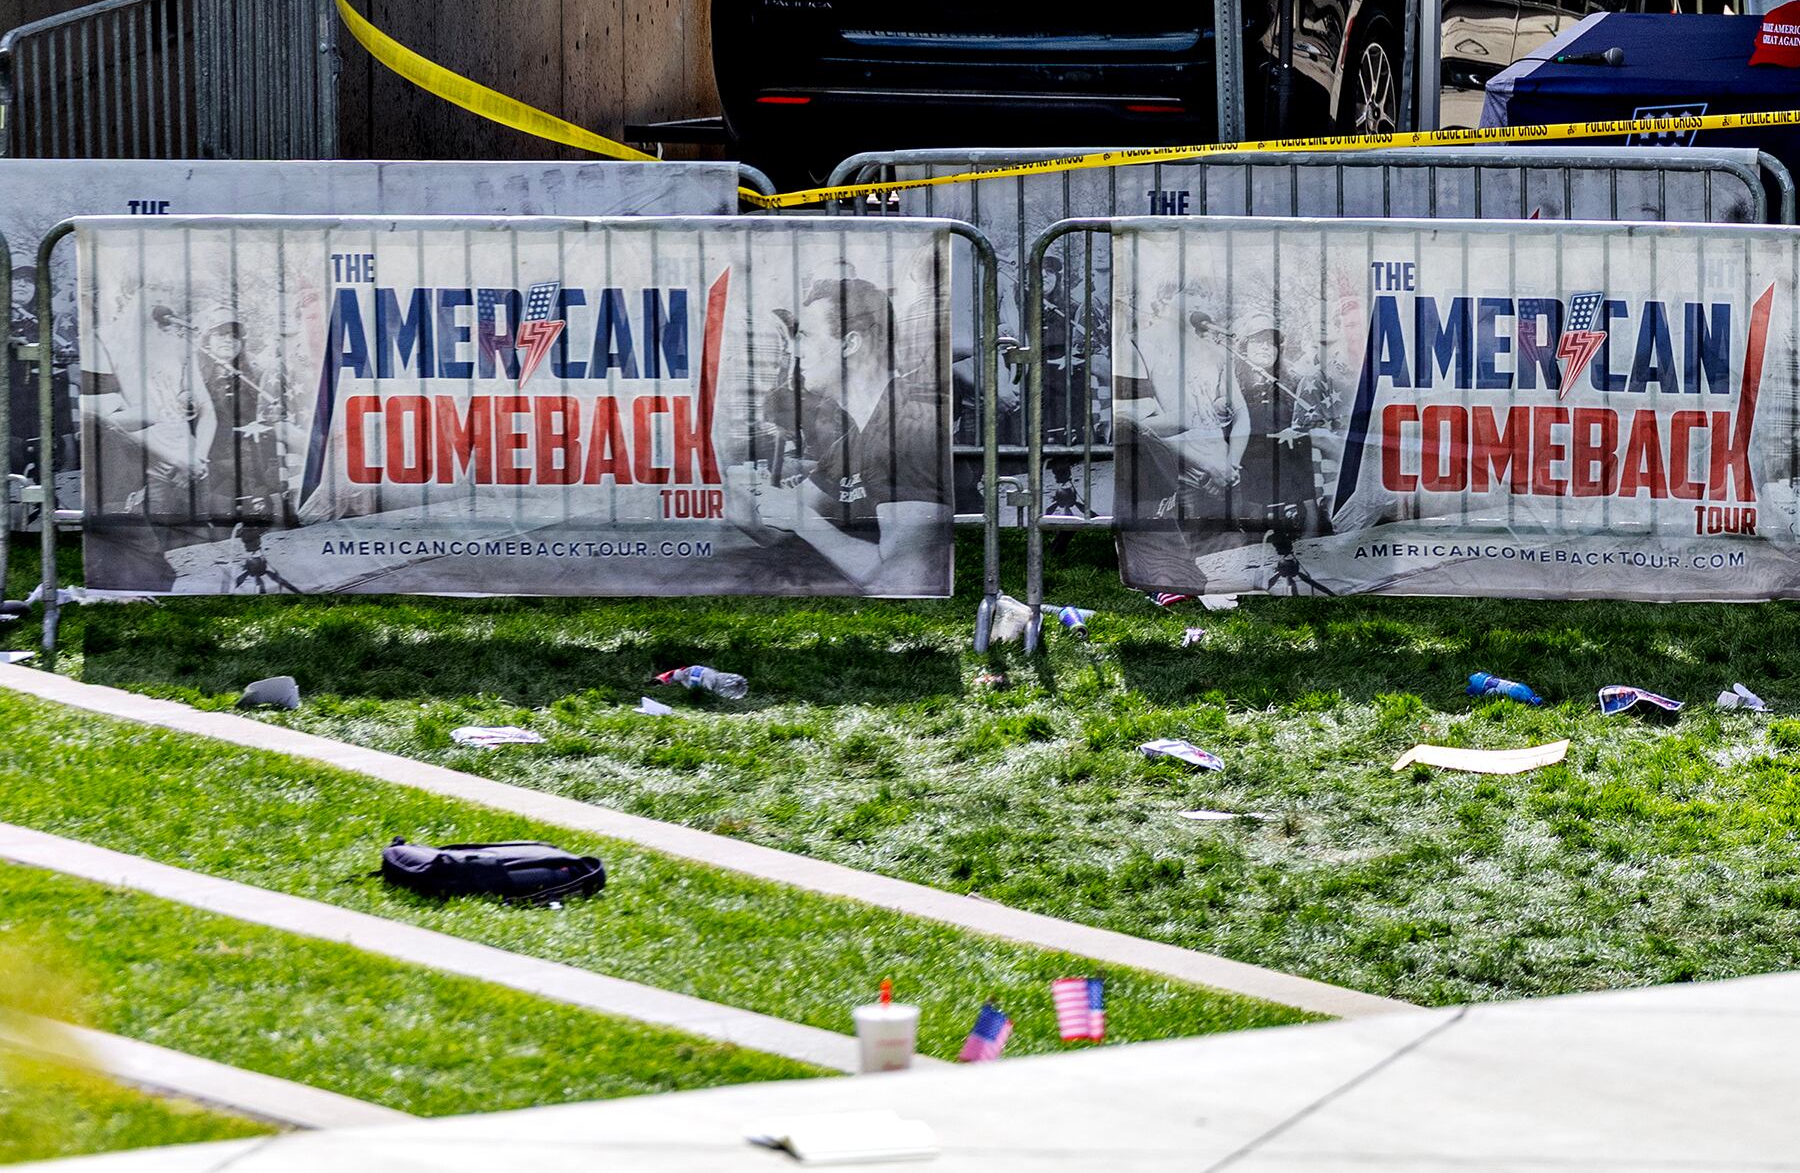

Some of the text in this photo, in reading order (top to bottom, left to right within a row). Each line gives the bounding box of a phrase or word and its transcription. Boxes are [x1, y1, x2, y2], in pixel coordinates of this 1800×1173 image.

[1586, 116, 1703, 133] POLICE LINE DO NOT CROSS
[1740, 112, 1771, 125] POLICE
[1773, 111, 1793, 124] LINE
[1431, 125, 1548, 141] POLICE LINE DO NOT CROSS
[1147, 191, 1190, 215] THE
[331, 253, 375, 283] THE
[1372, 262, 1416, 291] THE
[345, 266, 731, 485] COMEBACK
[1381, 282, 1775, 503] COMEBACK
[660, 489, 723, 519] TOUR
[1694, 505, 1756, 536] TOUR
[322, 541, 713, 557] AMERICANCOMEBACKTOUR.COM
[1354, 543, 1745, 569] AMERICANCOMEBACKTOUR.COM
